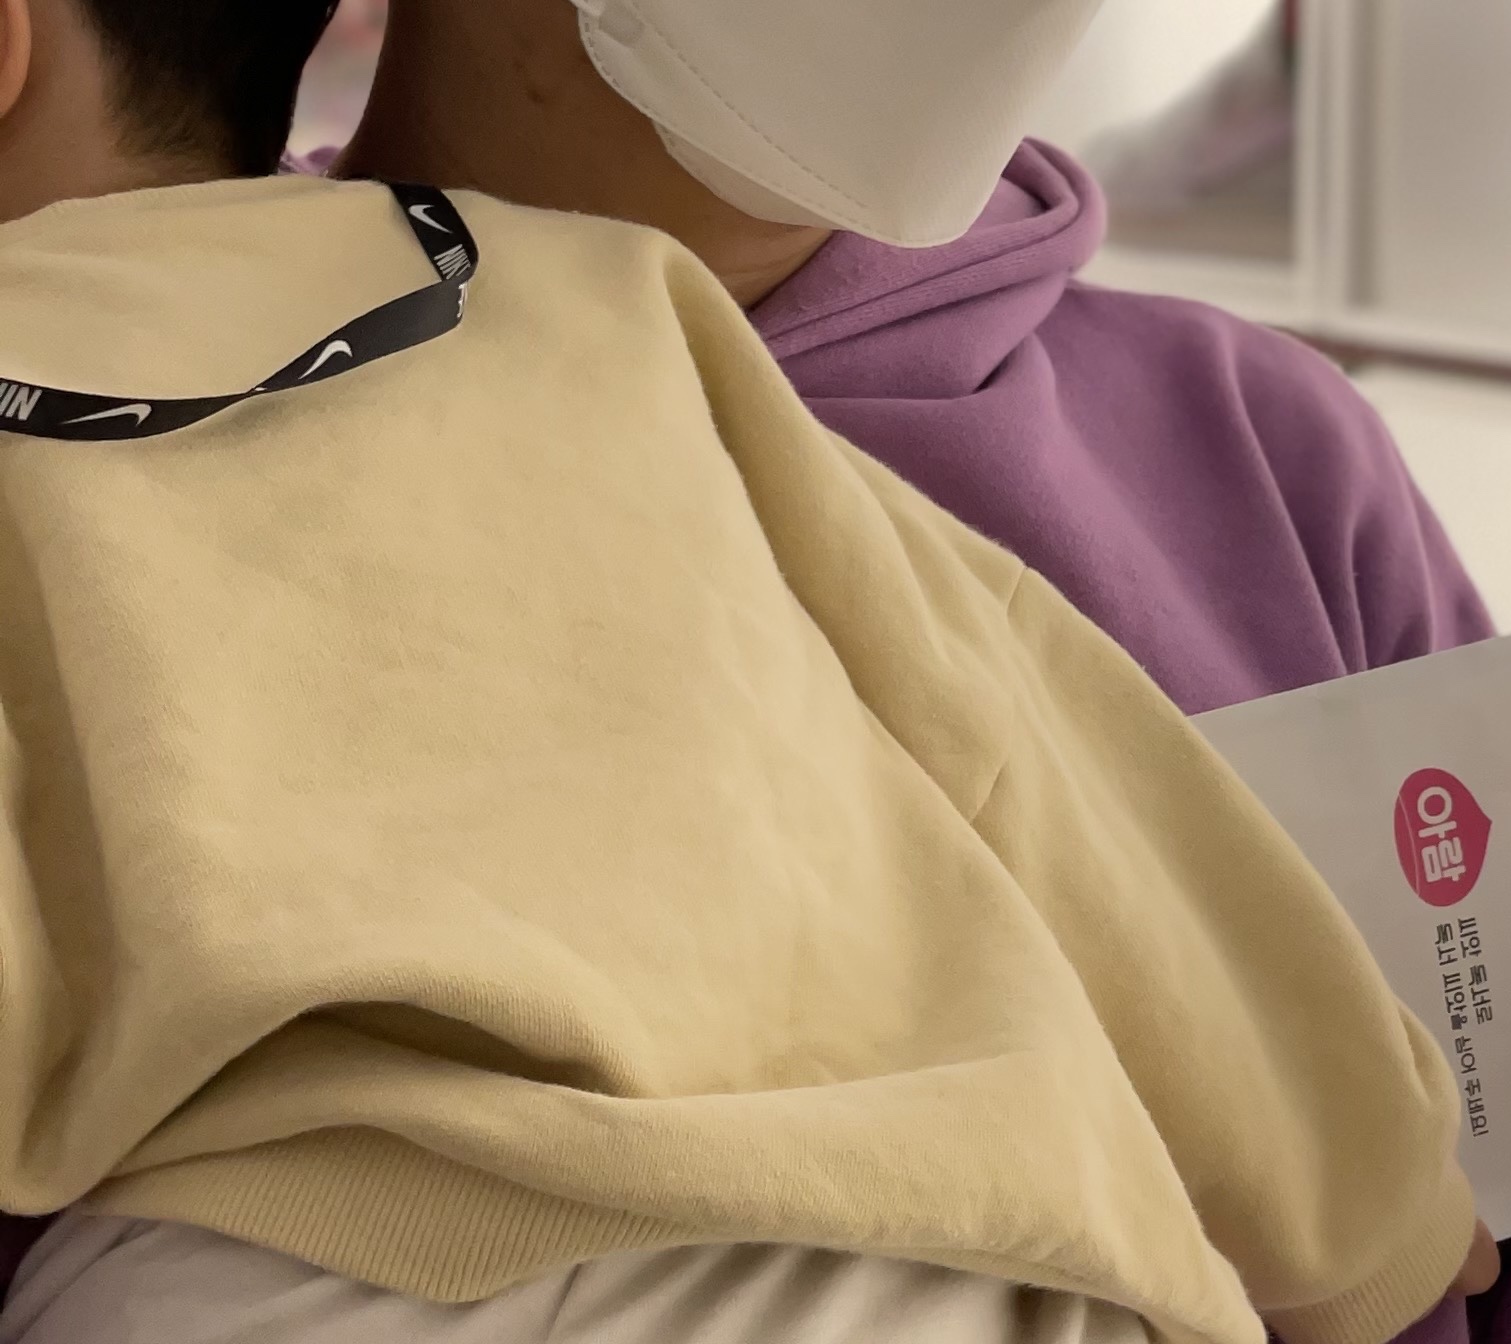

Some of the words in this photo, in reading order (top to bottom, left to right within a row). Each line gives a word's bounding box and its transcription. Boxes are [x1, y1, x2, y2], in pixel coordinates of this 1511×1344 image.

[1417, 786, 1467, 883] 아람
[1435, 923, 1459, 966] 독서
[1457, 917, 1482, 958] 씨앗
[1468, 964, 1493, 1025] 독서로
[1455, 1035, 1477, 1074] 심어
[1464, 1078, 1489, 1137] 주세요!
